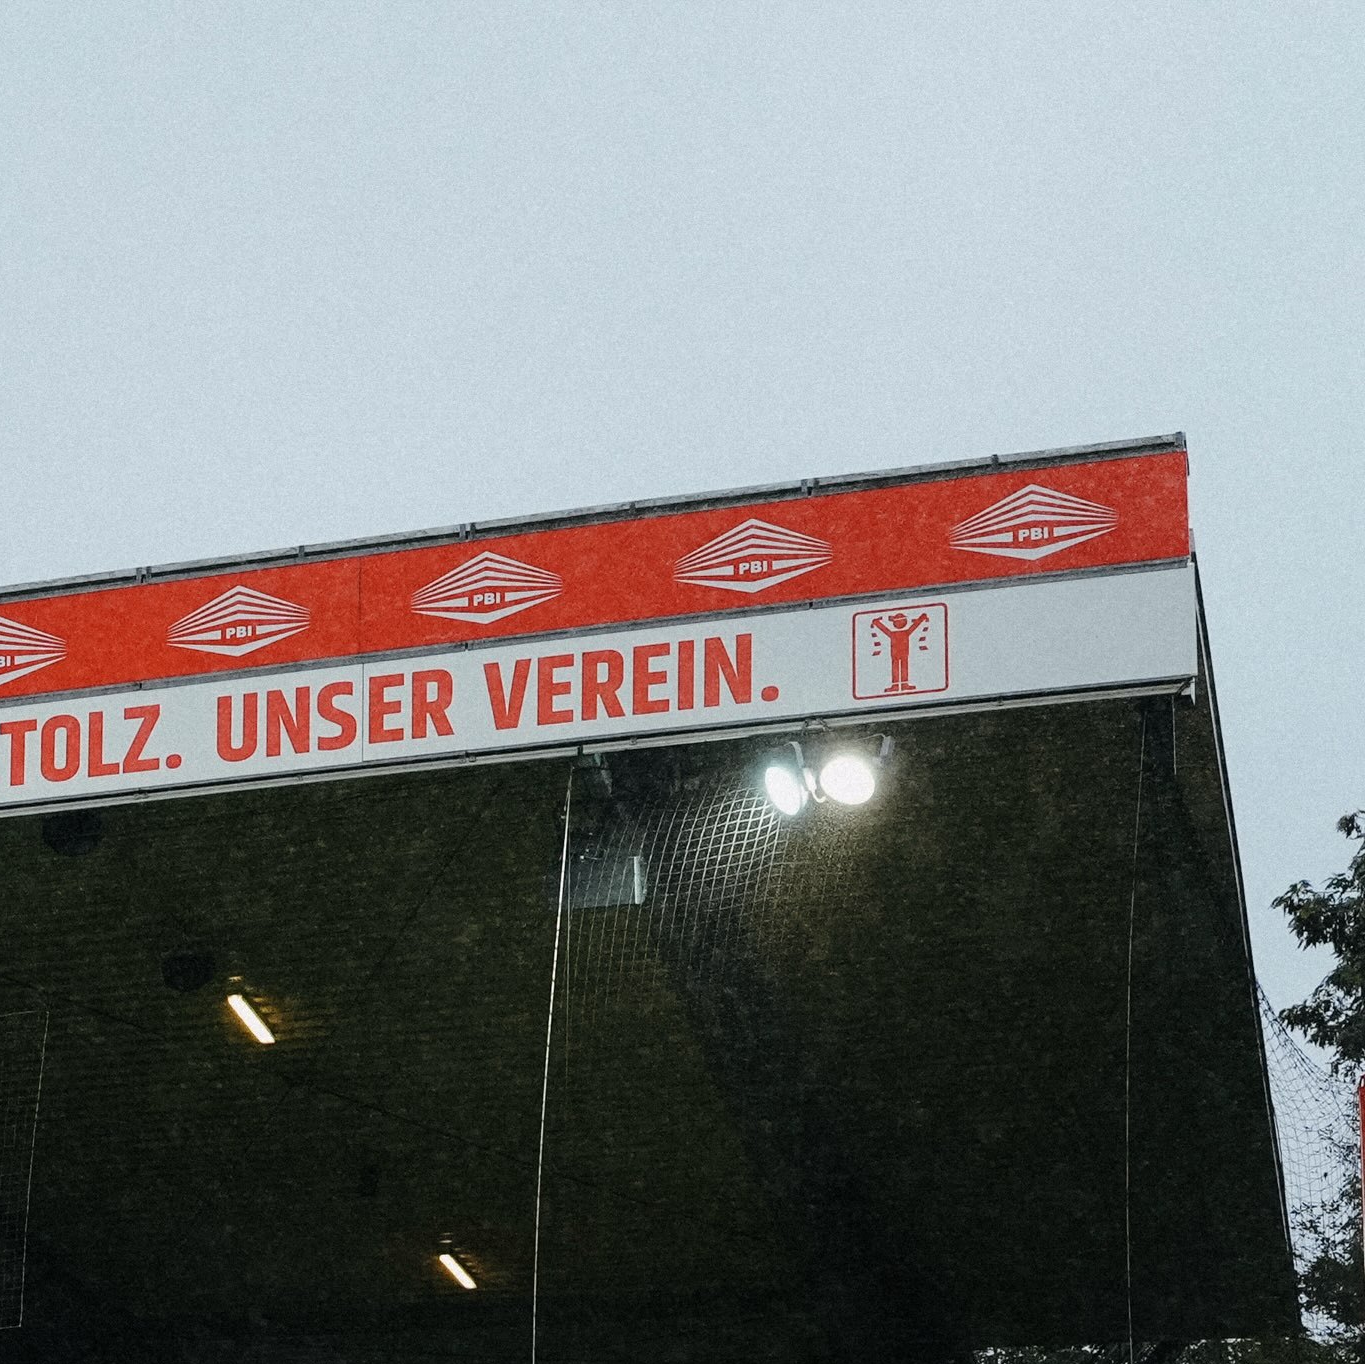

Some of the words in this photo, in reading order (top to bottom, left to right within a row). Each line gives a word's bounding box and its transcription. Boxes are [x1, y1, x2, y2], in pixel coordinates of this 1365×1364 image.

[1017, 526, 1050, 543] PBI
[738, 560, 769, 576] PBI
[473, 592, 501, 606] PBI
[225, 625, 253, 640] PBI
[215, 668, 454, 762] UNSER
[483, 633, 780, 731] VEREIN.
